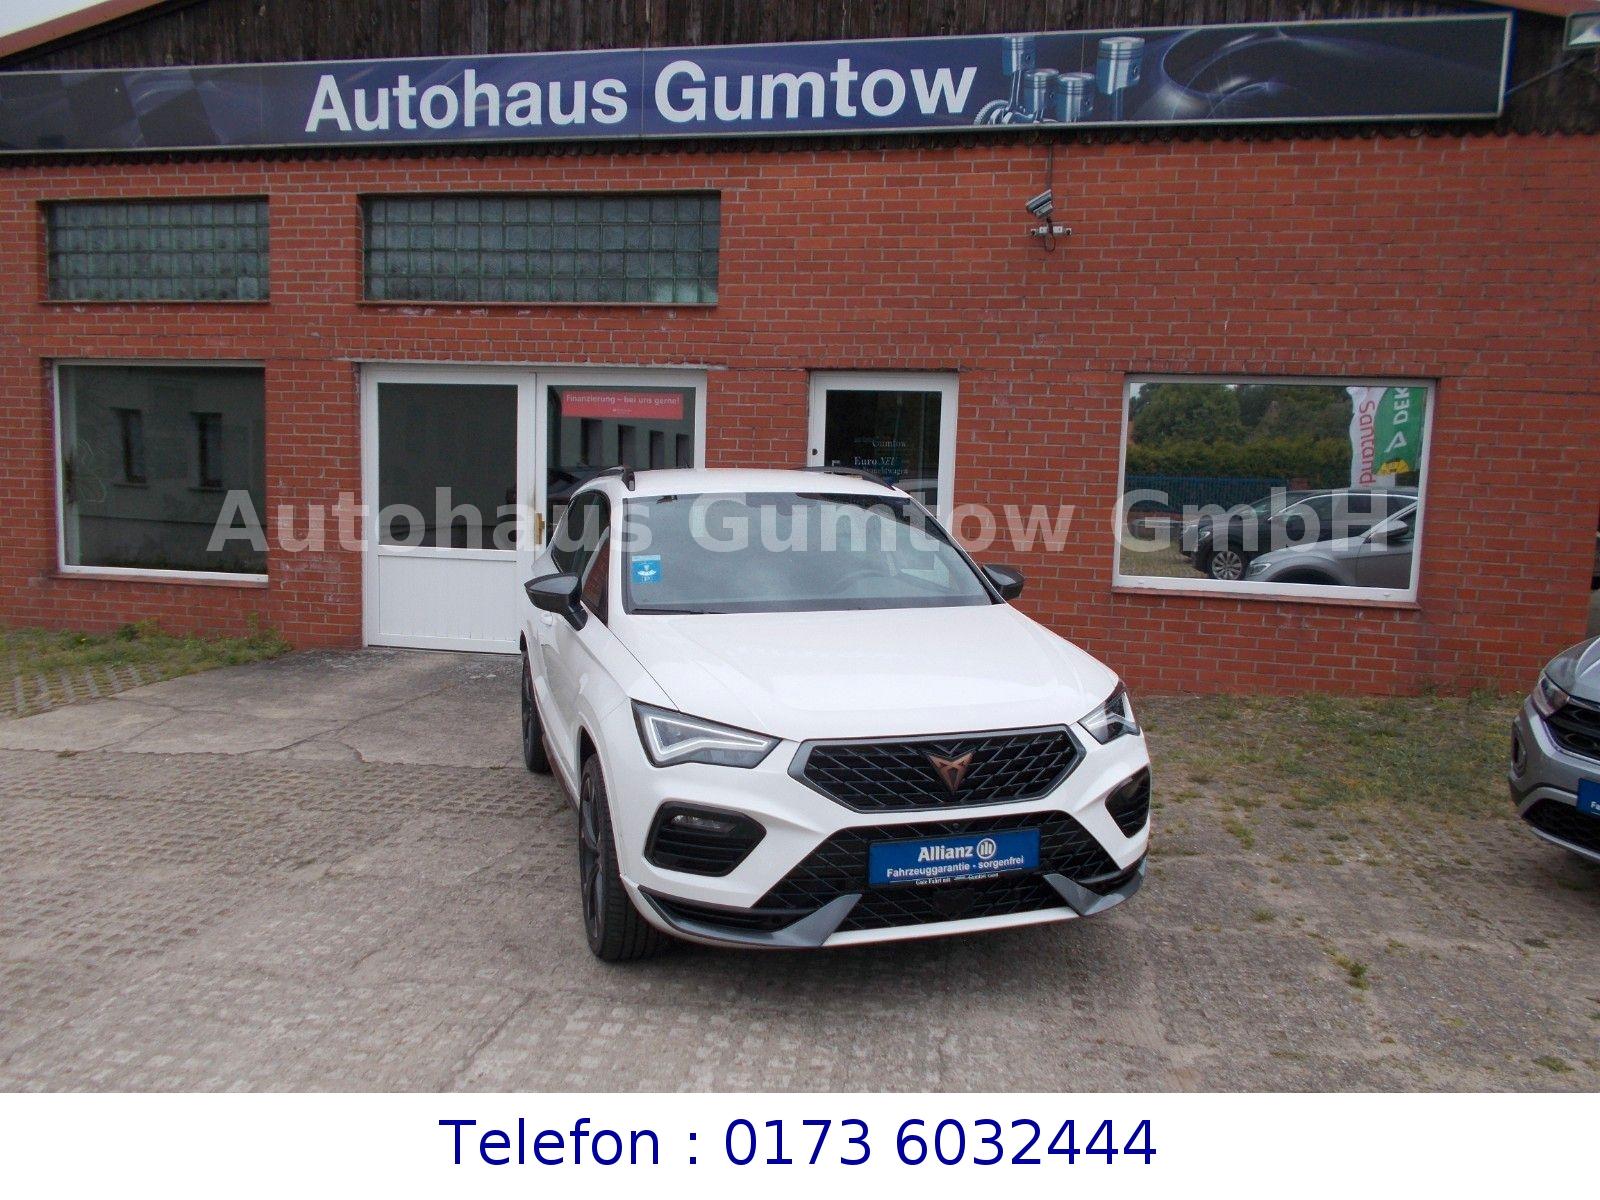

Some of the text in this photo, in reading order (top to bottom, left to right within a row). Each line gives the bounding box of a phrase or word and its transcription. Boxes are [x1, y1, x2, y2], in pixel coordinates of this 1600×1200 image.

[305, 58, 977, 133] Autohaus Gumtow
[566, 394, 616, 405] Finanzierung
[623, 395, 637, 404] bei
[638, 397, 653, 405] uns
[917, 844, 974, 862] Allianz
[886, 862, 970, 878] Fahrzeuggarantie
[978, 855, 1024, 870] sorgenfrei
